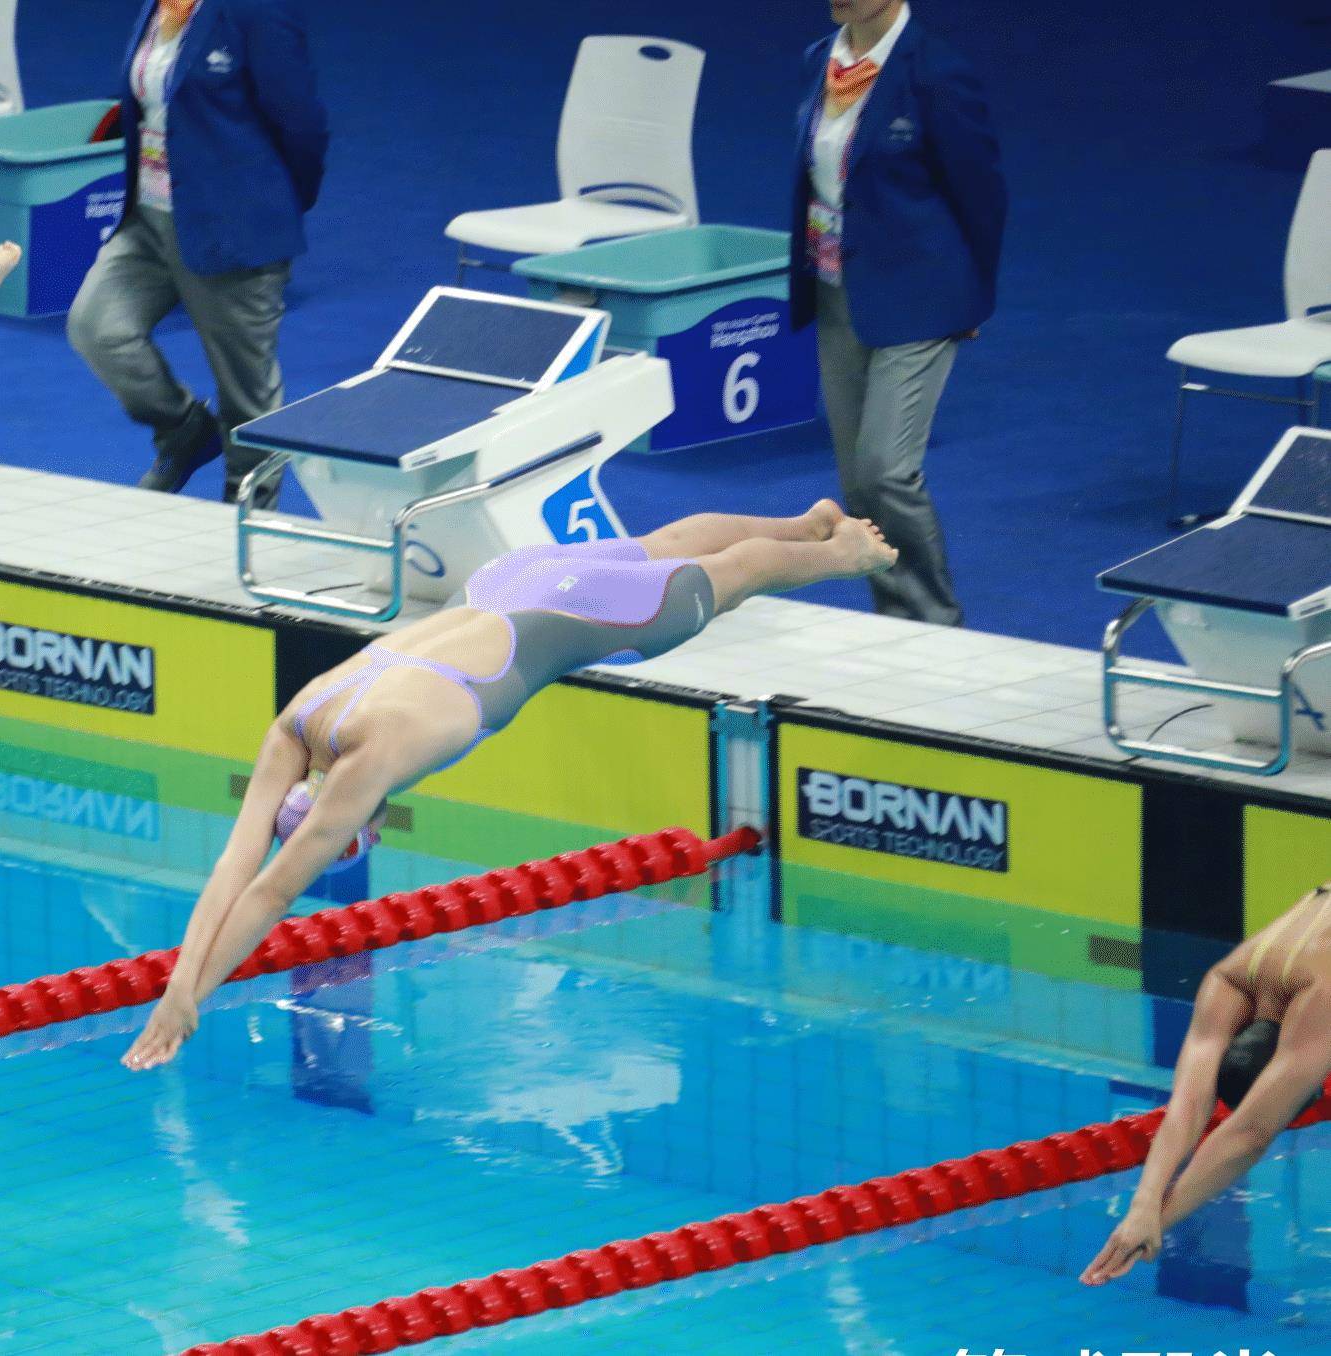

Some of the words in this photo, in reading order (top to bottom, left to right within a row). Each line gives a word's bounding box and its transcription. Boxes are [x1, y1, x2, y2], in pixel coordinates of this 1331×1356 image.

[722, 351, 761, 424] 6
[566, 498, 597, 543] 5
[41, 675, 152, 712] TECHNOLOGY
[802, 771, 1006, 846] BORNAN
[808, 817, 879, 850] SPORTS
[881, 830, 1005, 870] TECHNOLOGY
